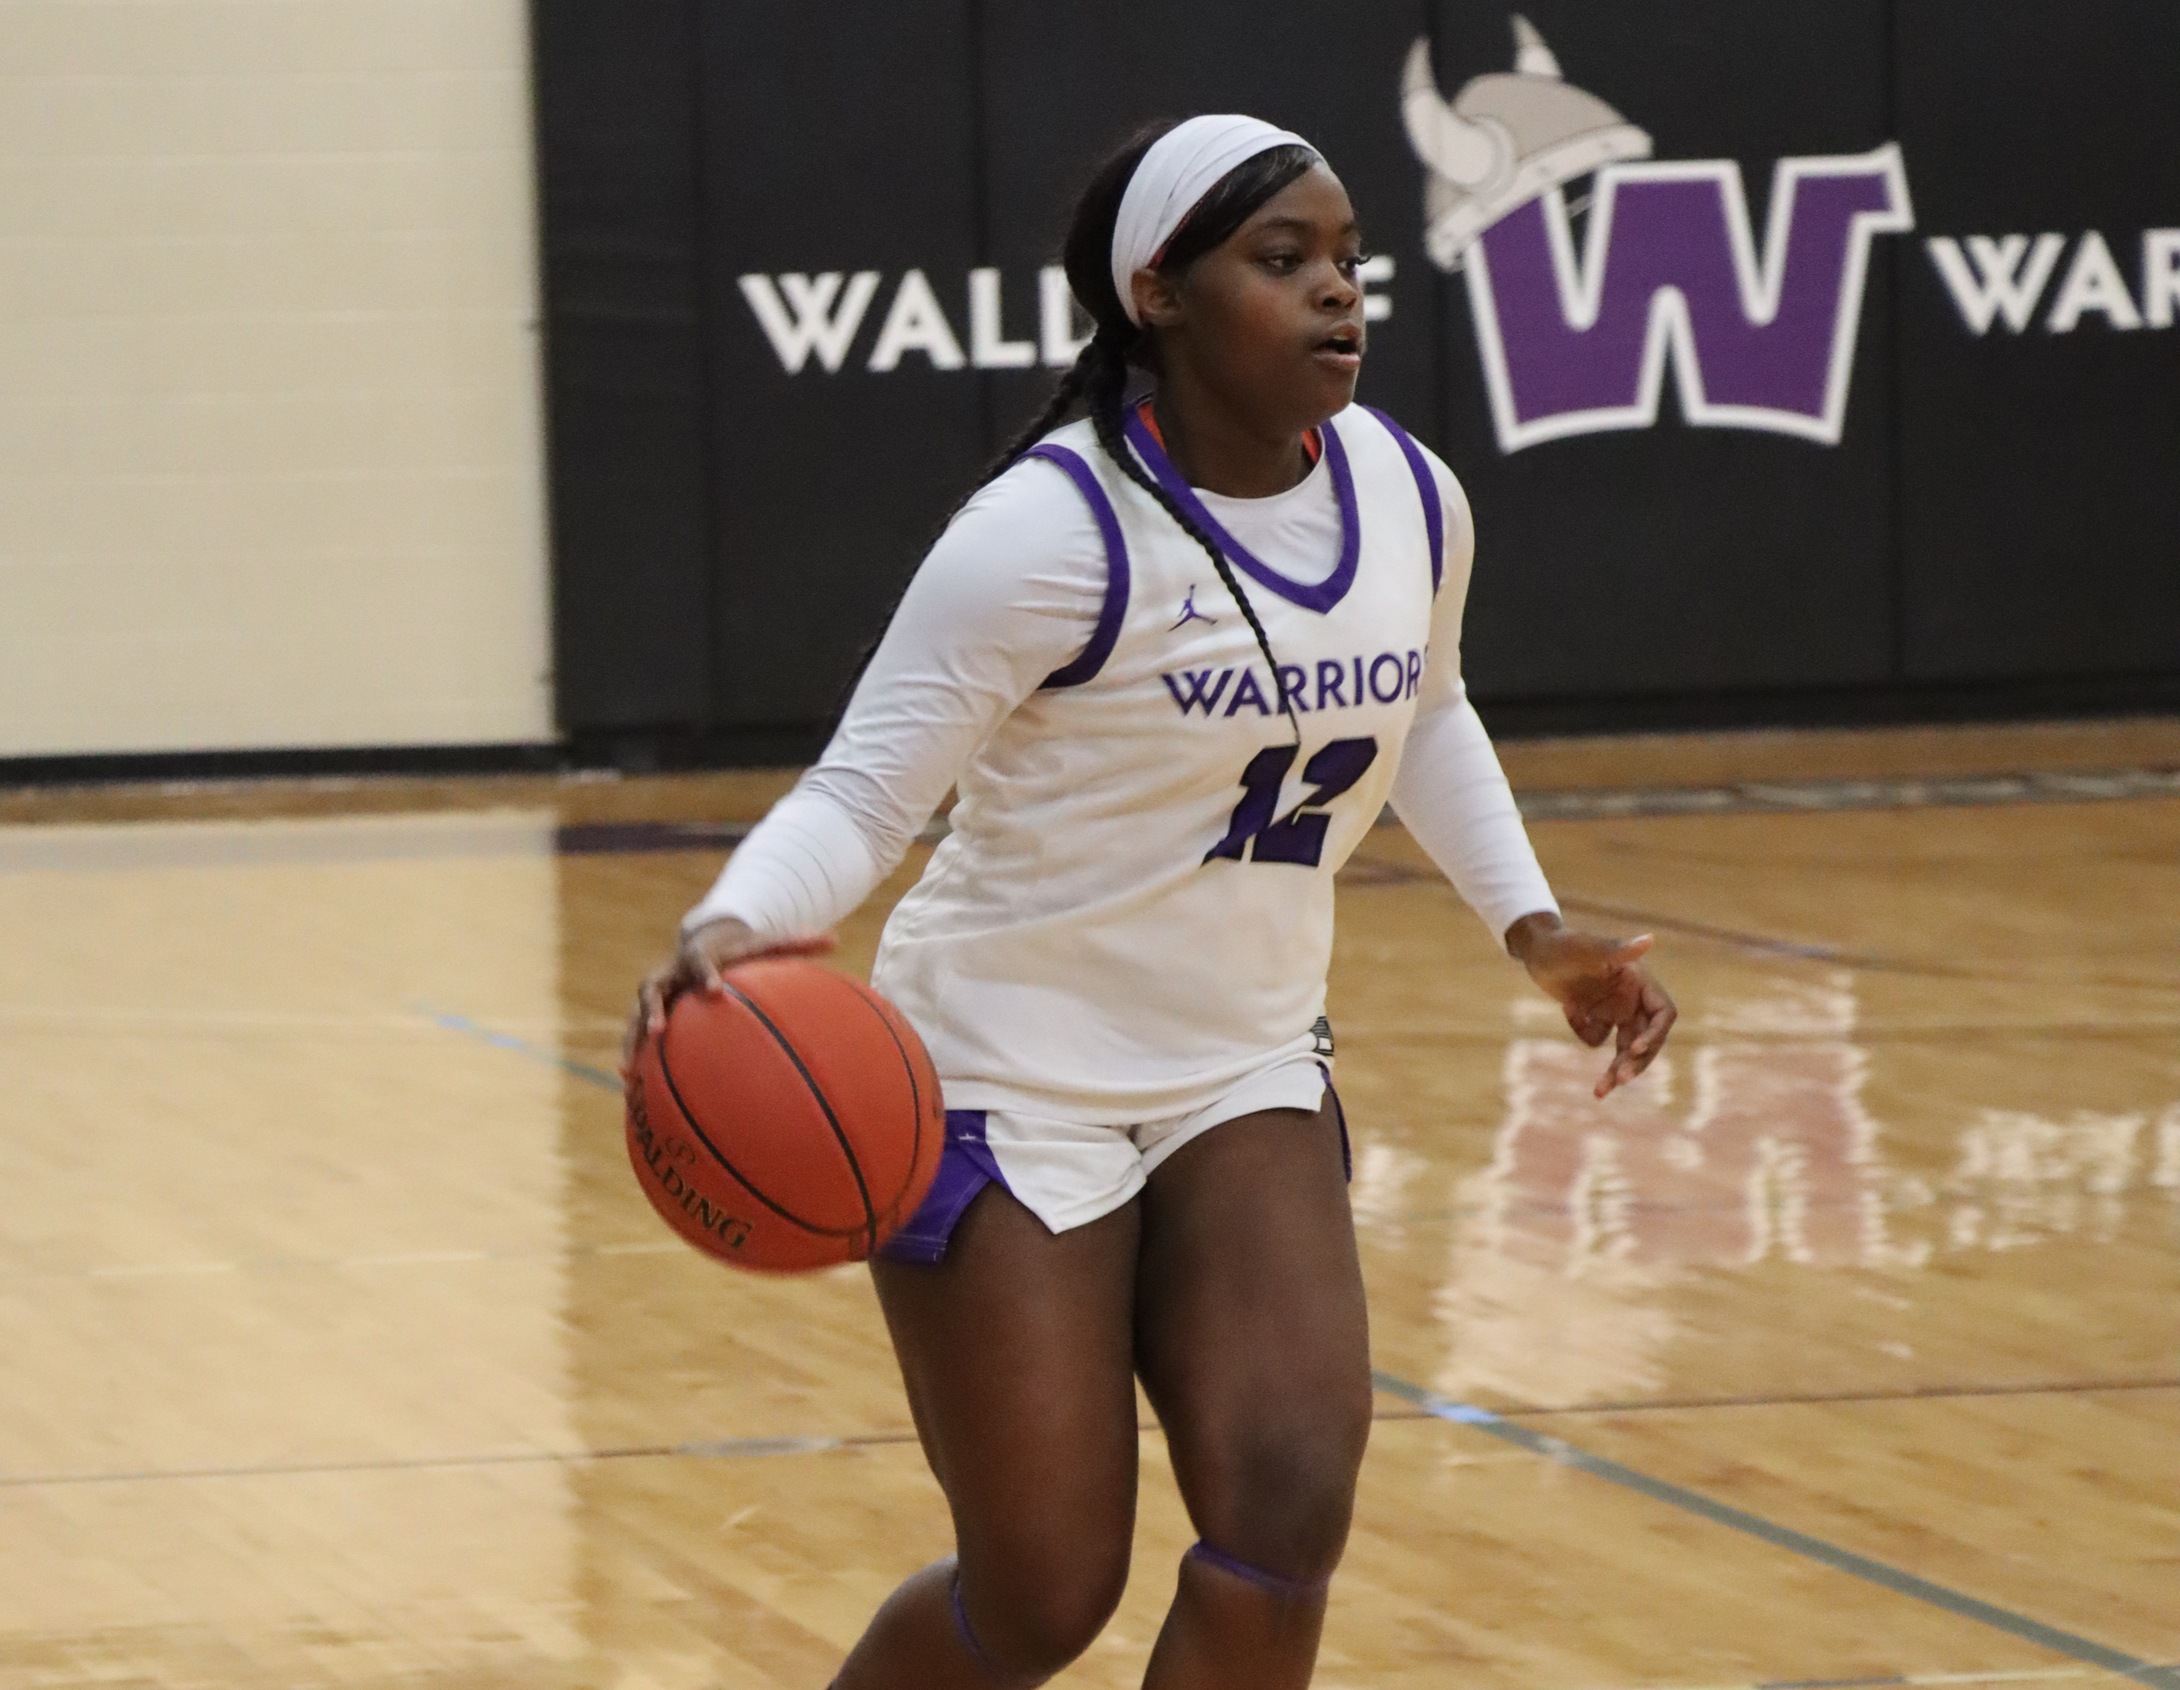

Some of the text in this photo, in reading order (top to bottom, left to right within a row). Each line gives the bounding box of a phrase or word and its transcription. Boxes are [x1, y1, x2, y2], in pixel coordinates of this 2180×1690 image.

[738, 228, 2180, 374] WALL WAR
[1463, 142, 1914, 454] W
[1160, 649, 1422, 717] WARRIOR
[1201, 736, 1378, 867] 12
[631, 1104, 753, 1249] PALDING
